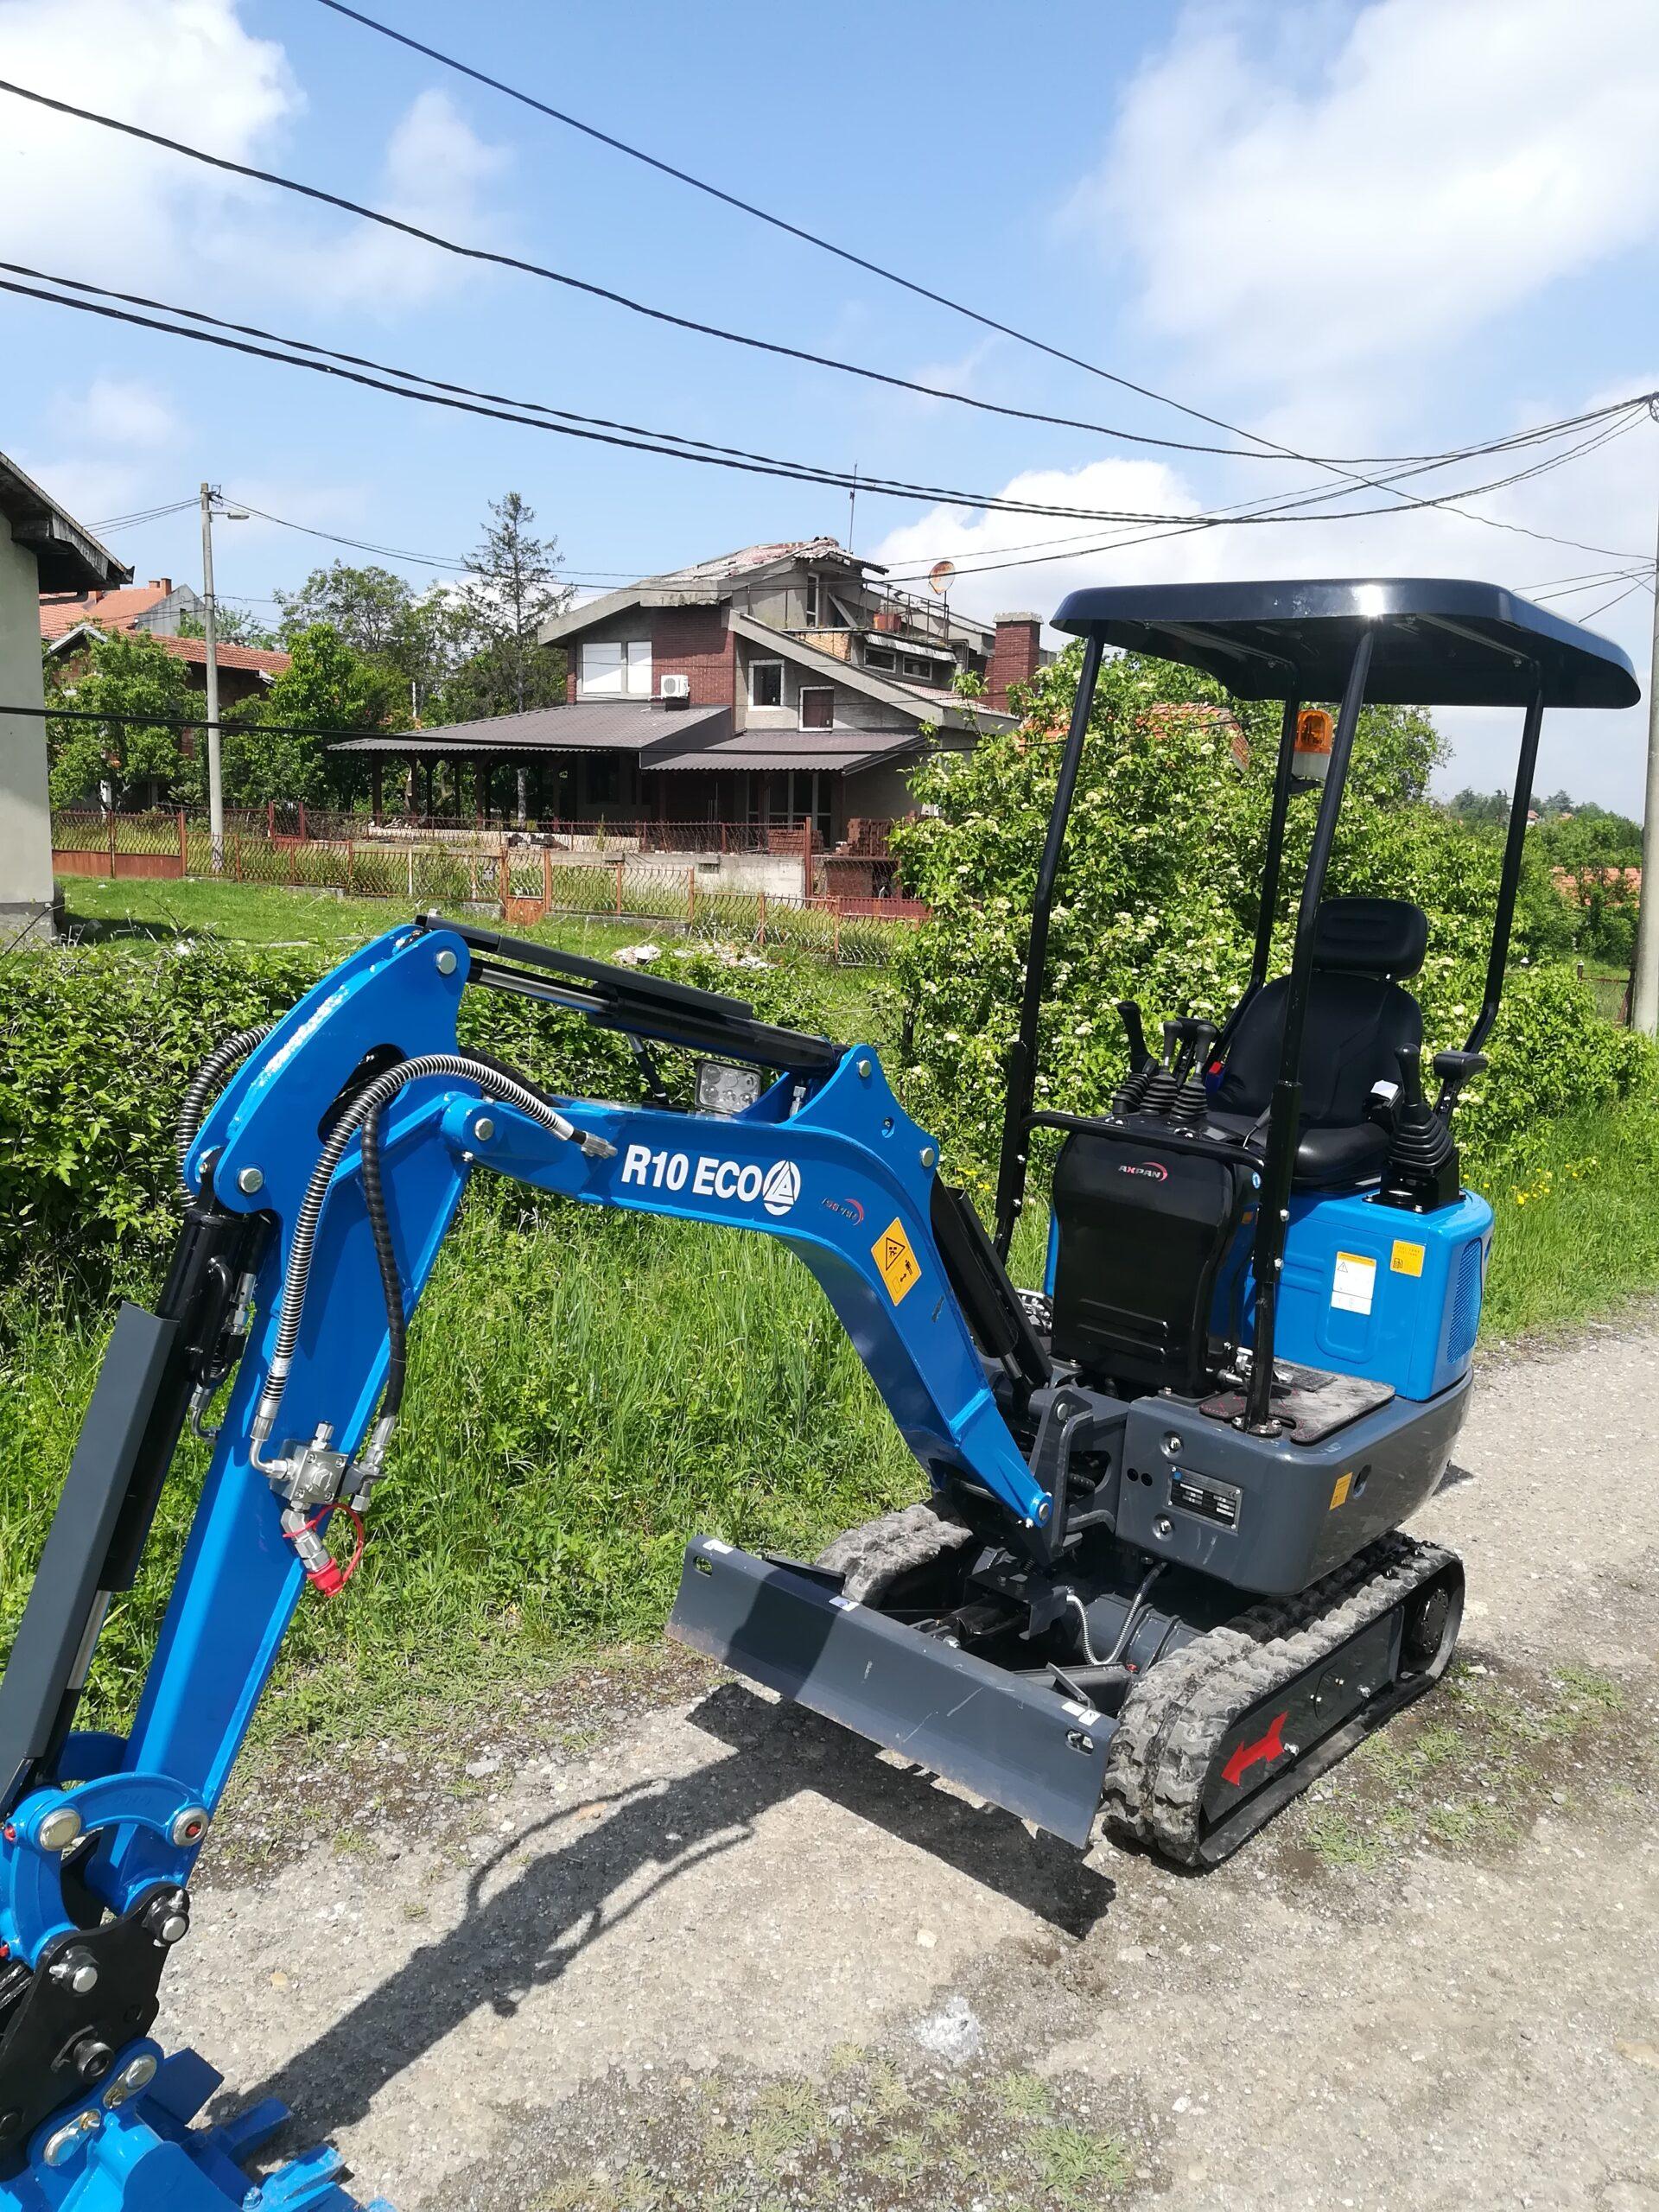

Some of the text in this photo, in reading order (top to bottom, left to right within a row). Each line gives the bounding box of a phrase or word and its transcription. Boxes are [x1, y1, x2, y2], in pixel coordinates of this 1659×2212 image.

[621, 1144, 763, 1202] R10 ECO
[1118, 1165, 1161, 1179] AXPAN
